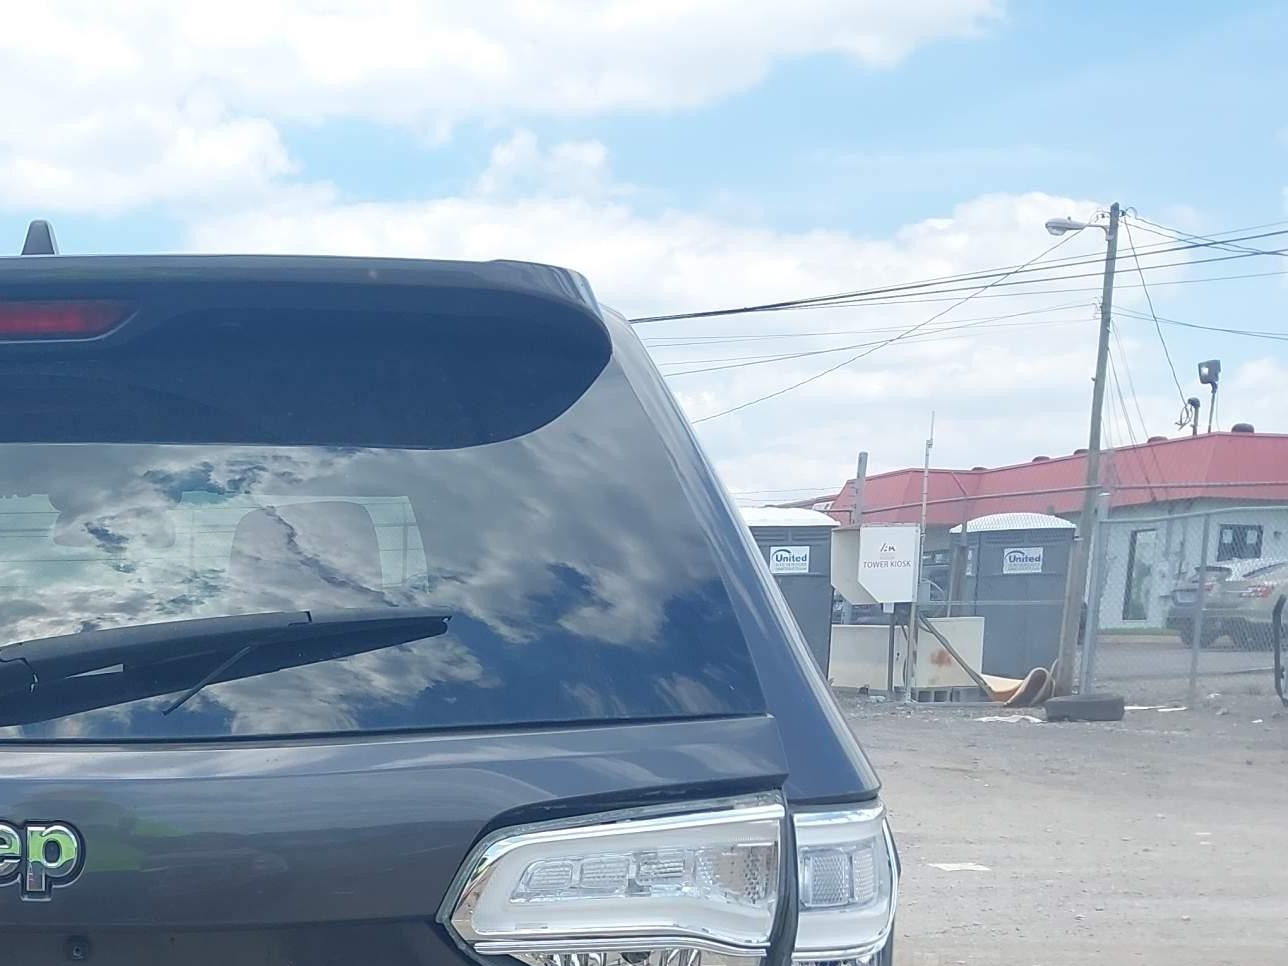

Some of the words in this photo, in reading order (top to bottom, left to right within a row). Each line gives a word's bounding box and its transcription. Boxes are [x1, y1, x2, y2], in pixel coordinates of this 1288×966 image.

[775, 553, 807, 562] United
[1008, 554, 1041, 562] United
[863, 560, 889, 568] TOWER
[890, 560, 912, 568] KIOSK
